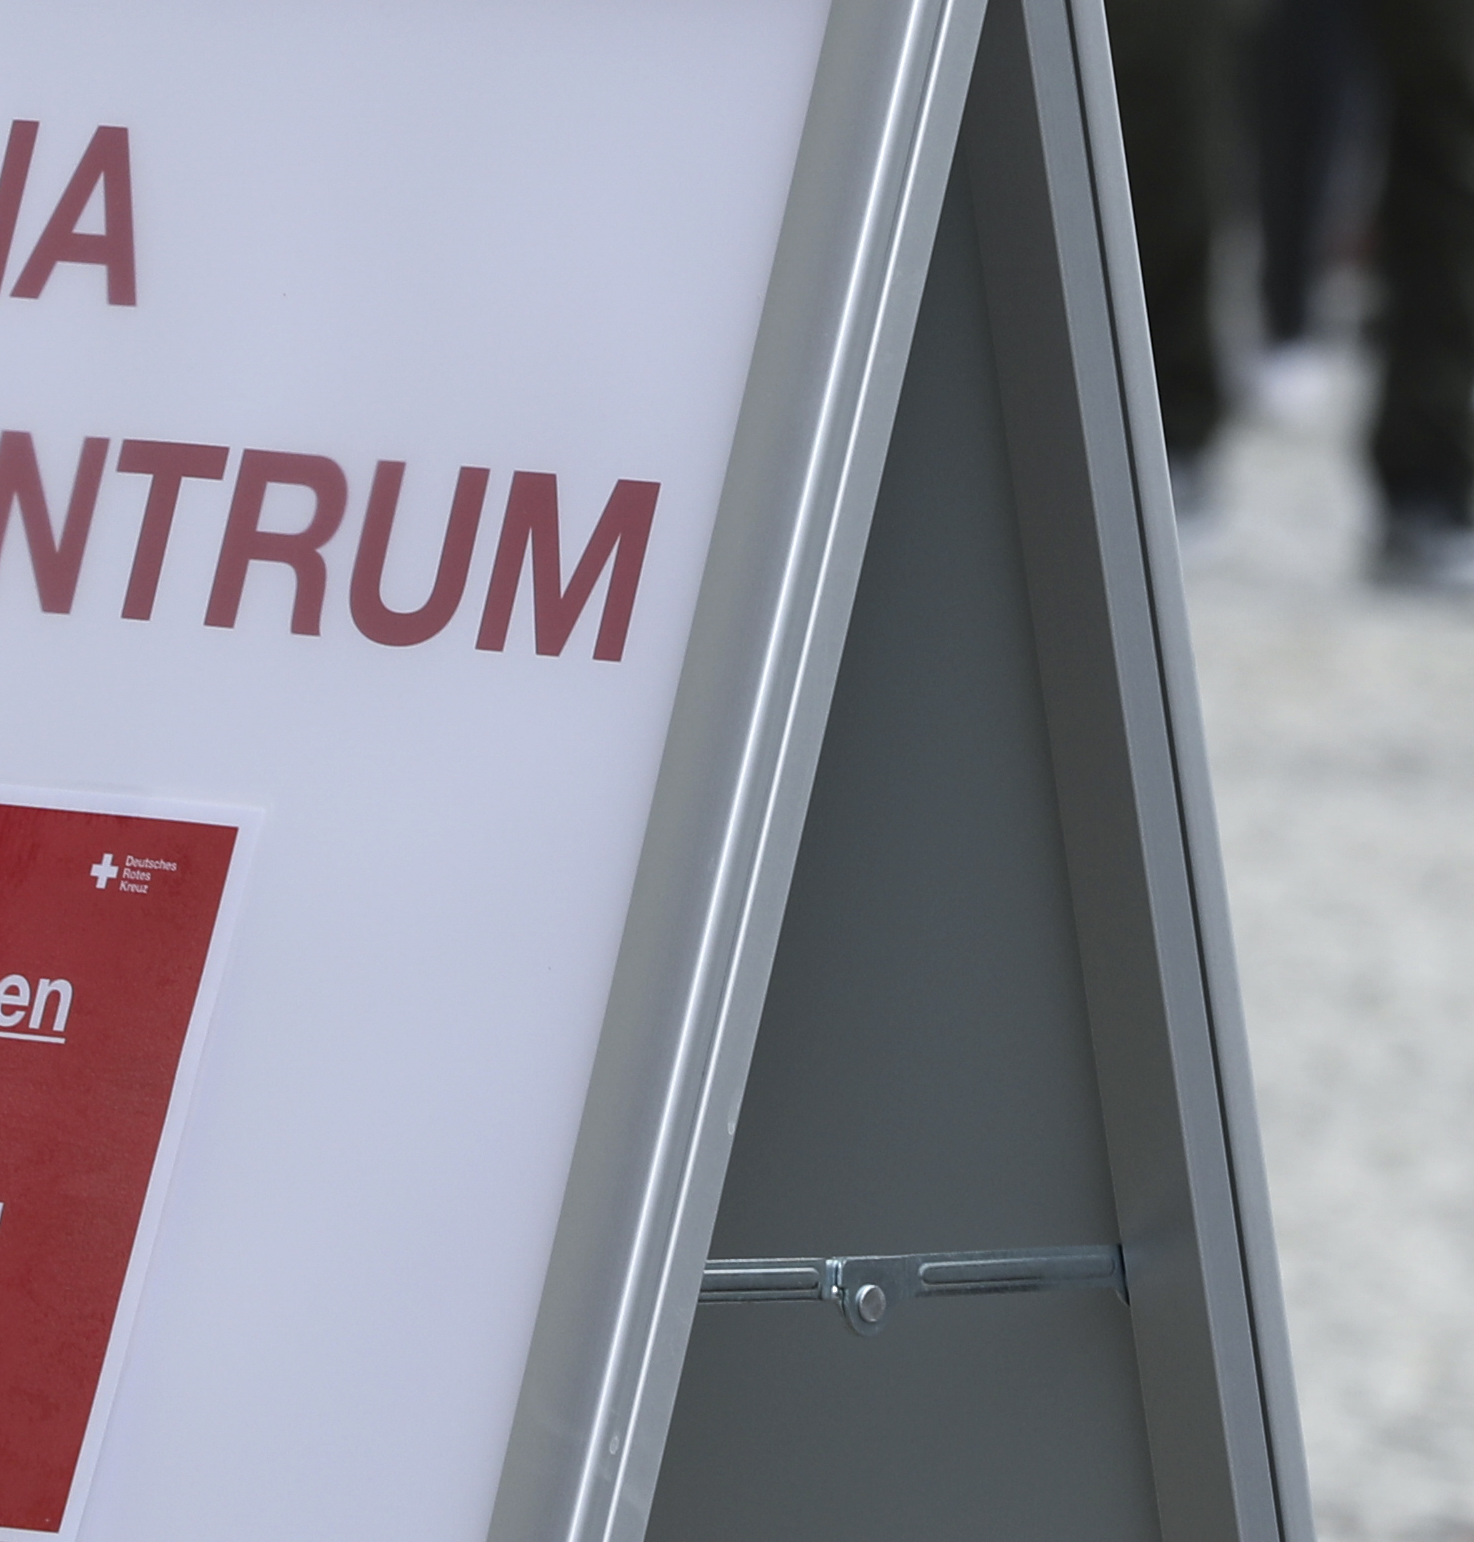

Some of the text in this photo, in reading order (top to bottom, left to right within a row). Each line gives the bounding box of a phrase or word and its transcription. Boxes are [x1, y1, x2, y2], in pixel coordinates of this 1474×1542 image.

[126, 855, 177, 871] Deutsches
[123, 868, 151, 880] Rotes
[120, 881, 148, 893] Kreuz
